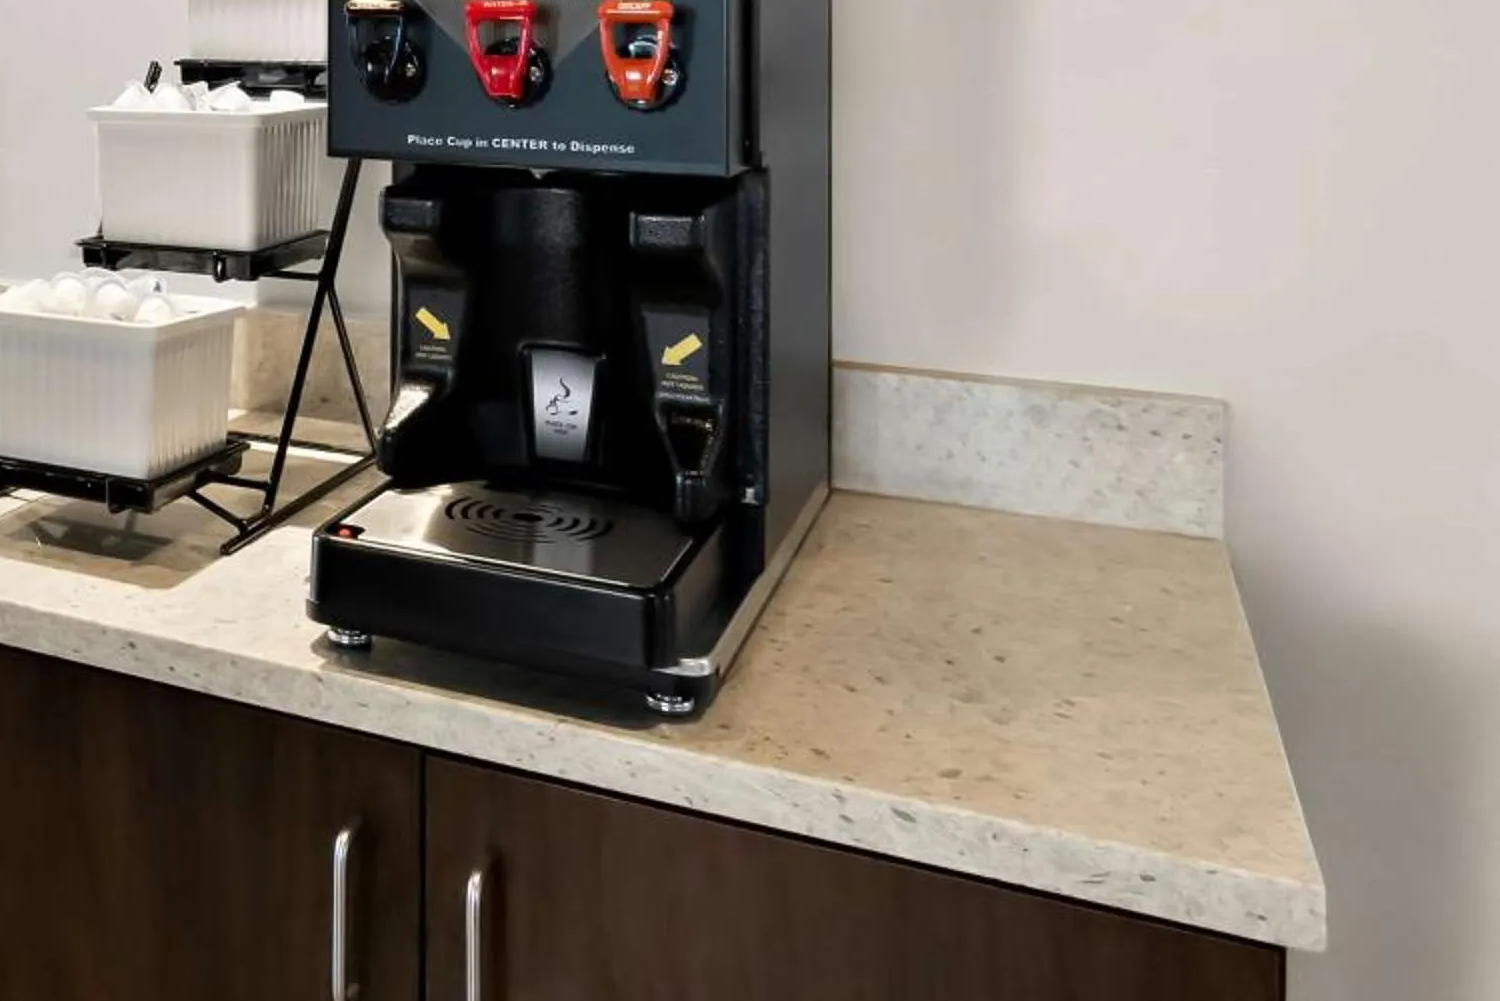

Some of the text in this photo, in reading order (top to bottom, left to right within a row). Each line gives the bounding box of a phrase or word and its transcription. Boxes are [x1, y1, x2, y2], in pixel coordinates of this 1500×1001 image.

[406, 133, 635, 155] Place Cup in CENTER to Dispense
